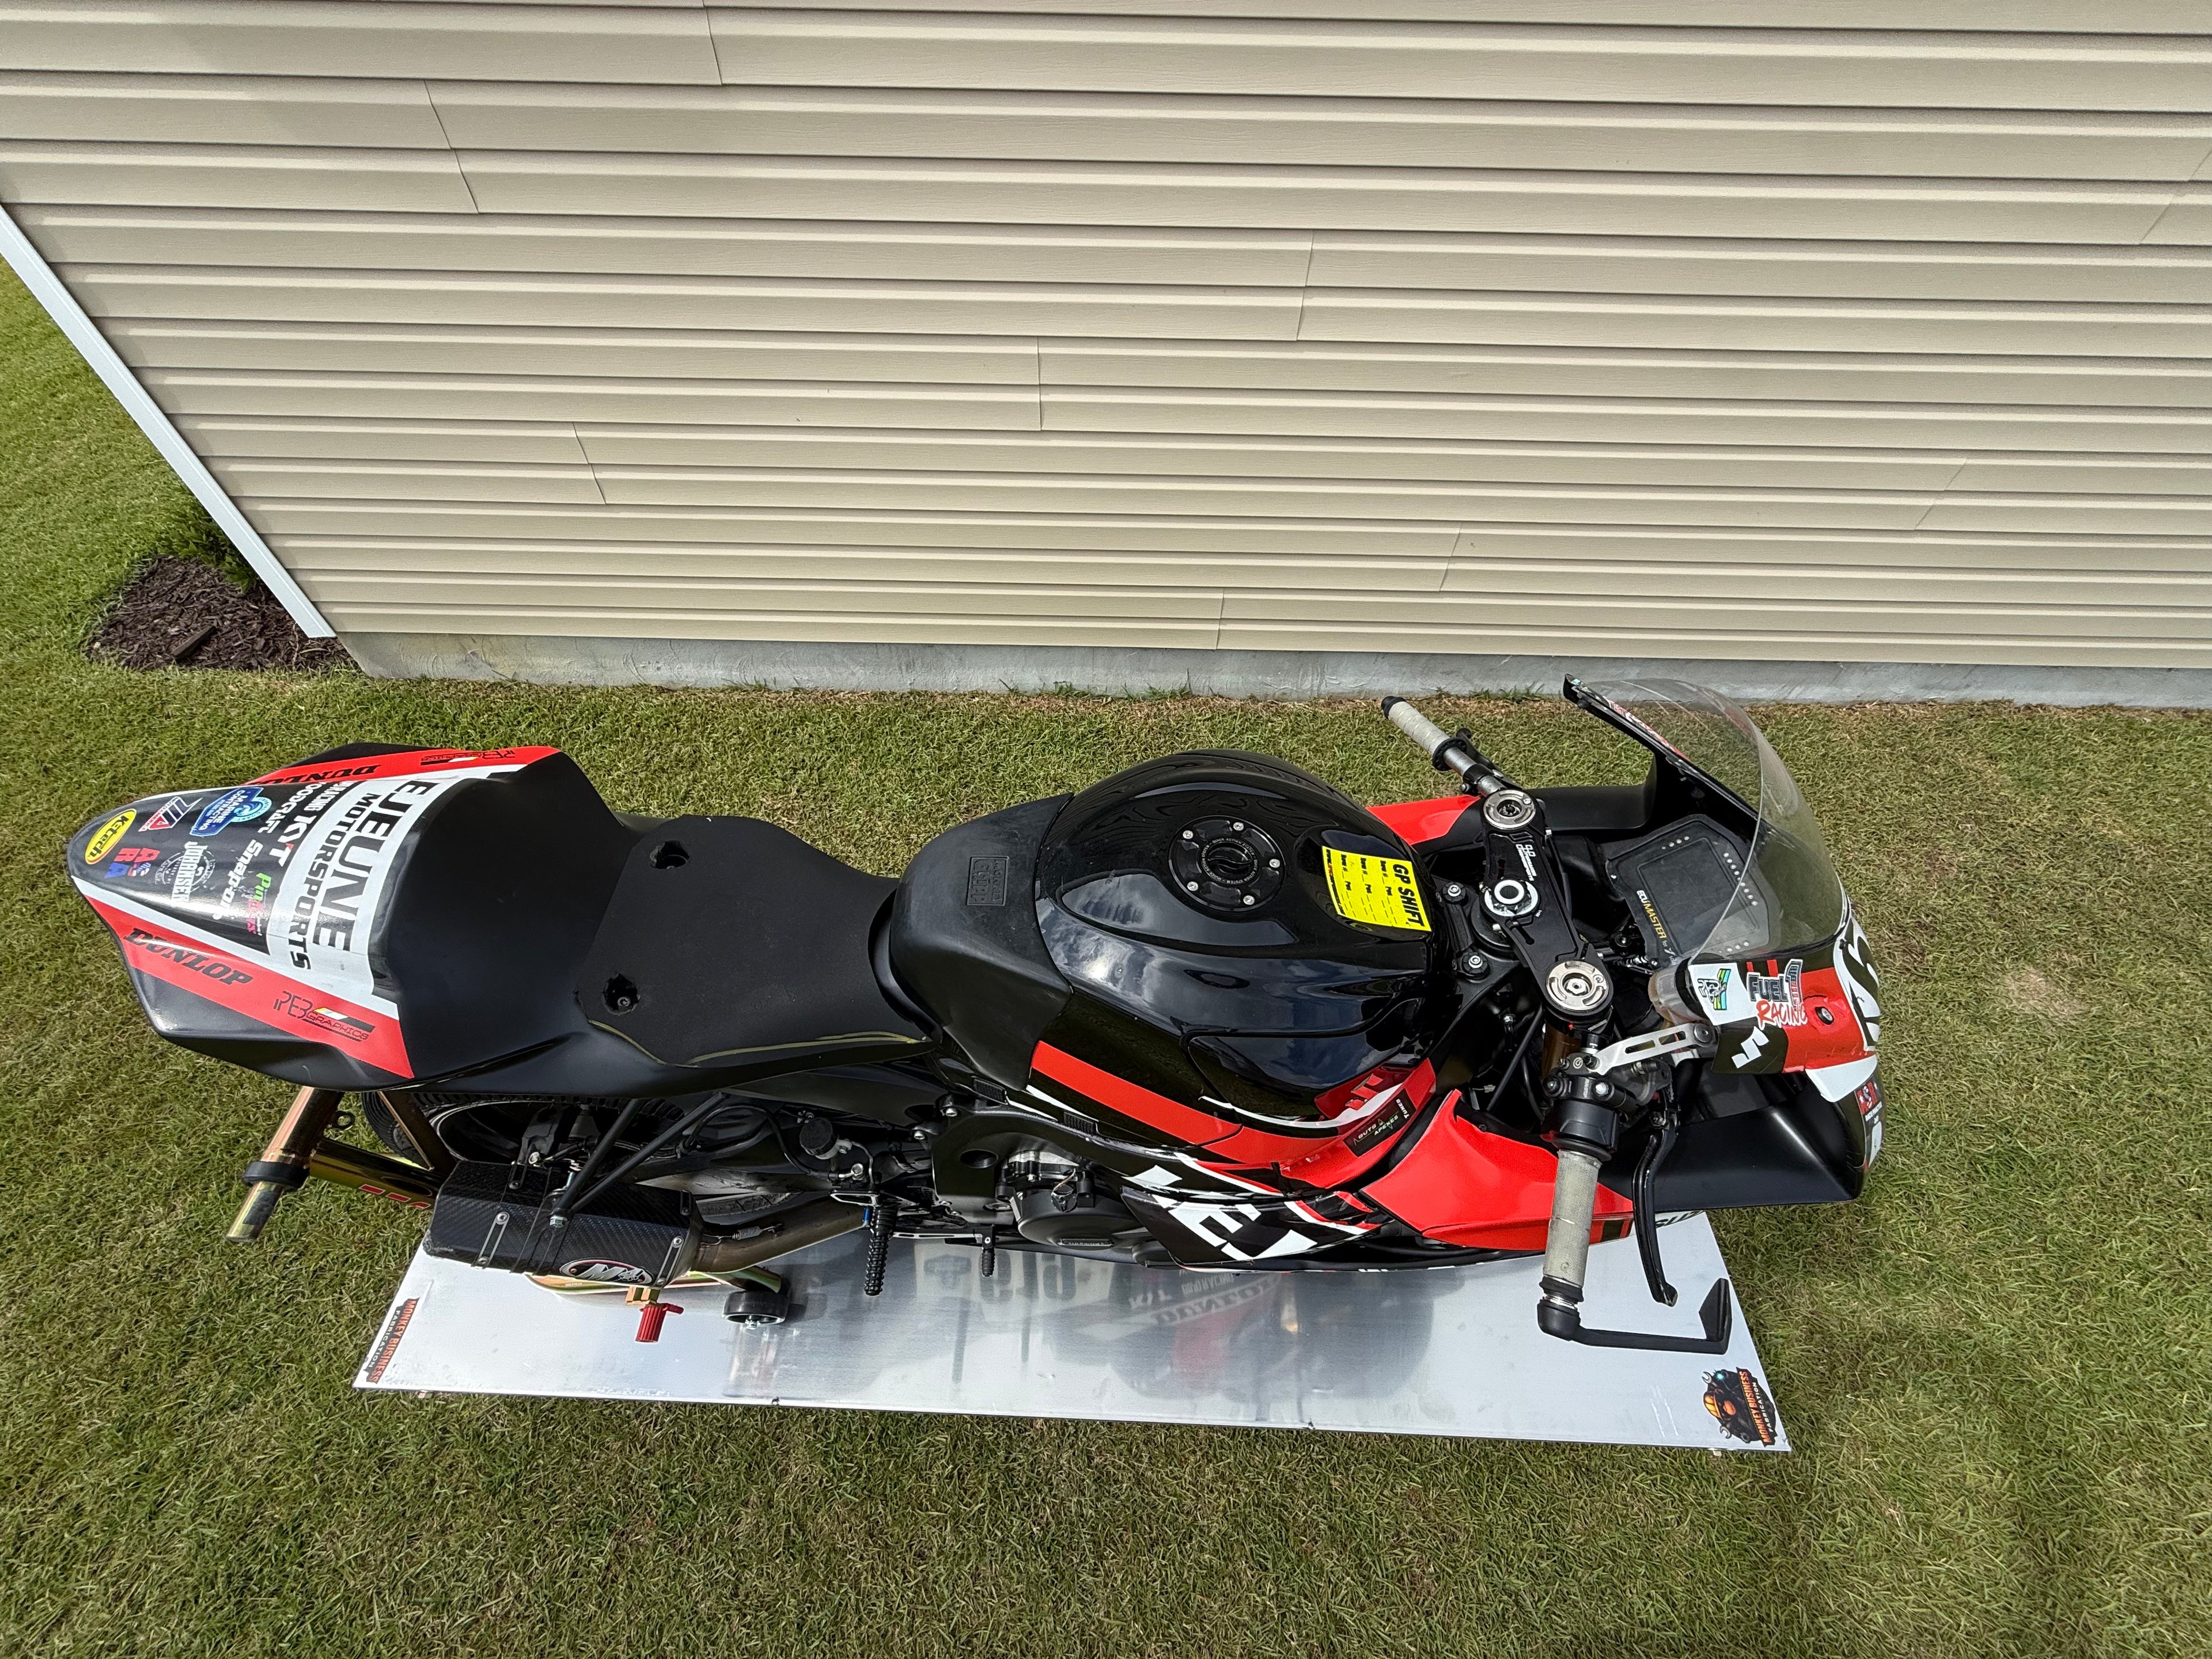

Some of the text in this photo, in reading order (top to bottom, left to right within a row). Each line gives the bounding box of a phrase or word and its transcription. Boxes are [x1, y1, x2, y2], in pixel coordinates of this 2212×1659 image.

[253, 764, 381, 785] DUNLO
[199, 789, 245, 831] CONTRACTING
[214, 794, 249, 824] MARINE
[257, 782, 326, 833] OODCRAFT
[288, 793, 382, 969] MOTORSPORTS
[1393, 864, 1425, 927] GP SHIFT
[1637, 890, 1667, 939] ECUMASTER
[123, 928, 253, 984] DUNLOP
[306, 1012, 369, 1040] GRAPHICS
[1756, 998, 1807, 1028] RACING
[369, 1310, 400, 1368] FABRICATION
[369, 1300, 416, 1382] MONKEY BUSINESS
[1738, 1370, 1772, 1443] MONKEY BUSINESS
[1752, 1382, 1774, 1433] FABRICATION
